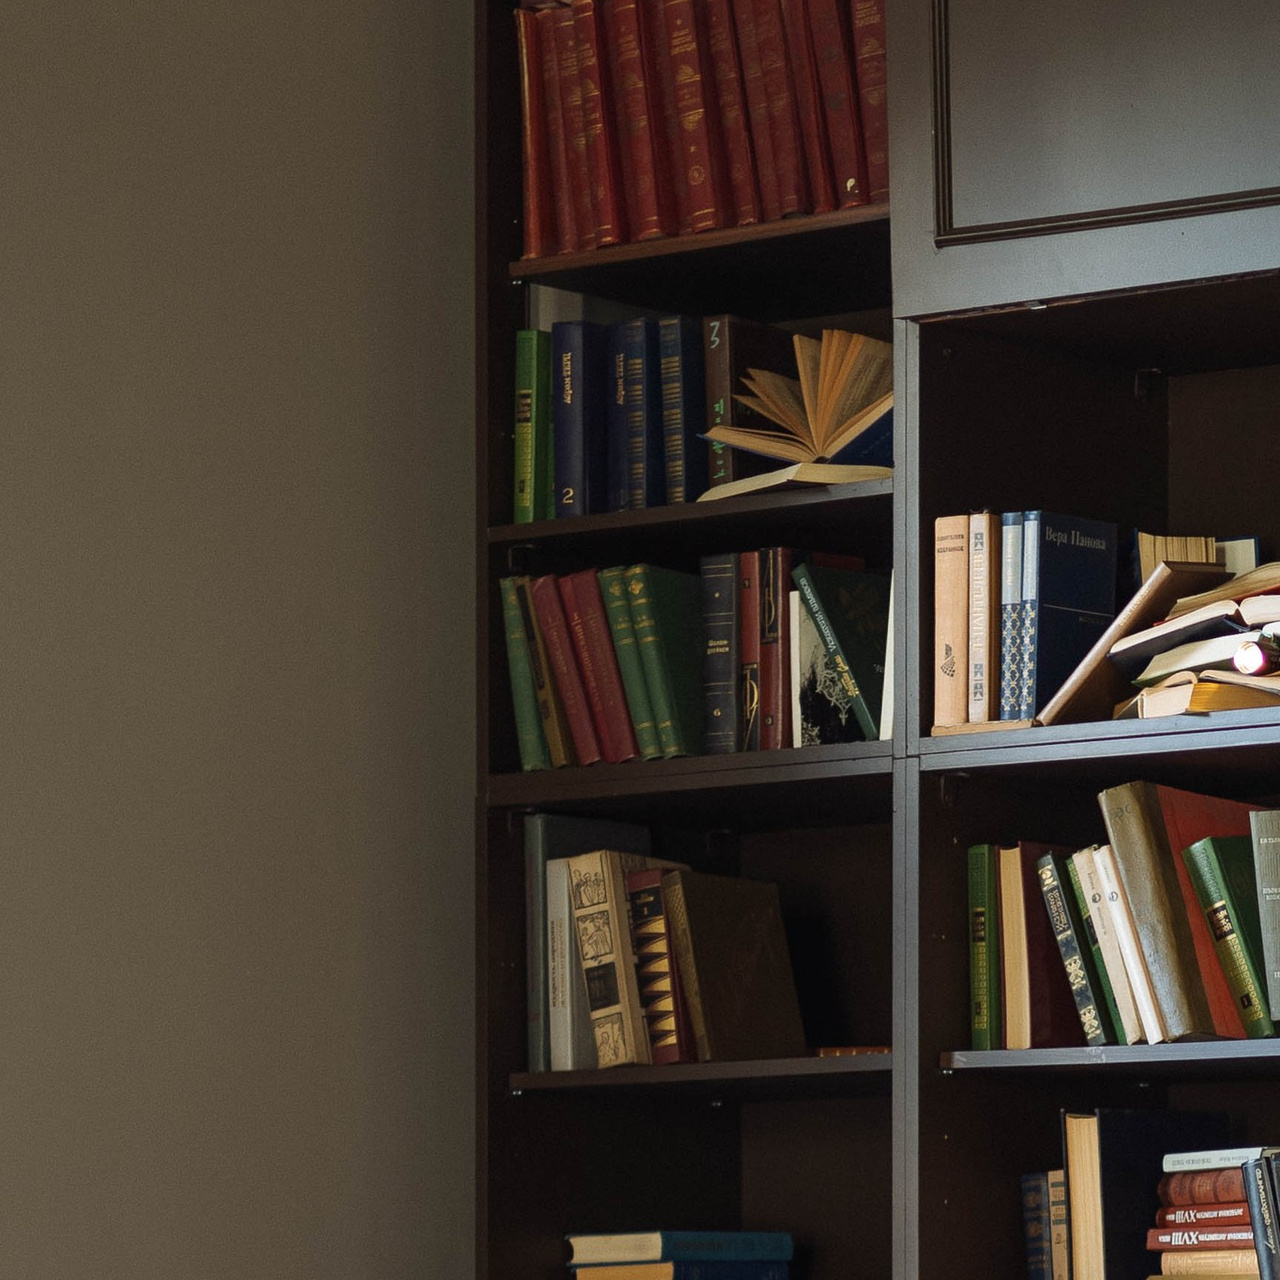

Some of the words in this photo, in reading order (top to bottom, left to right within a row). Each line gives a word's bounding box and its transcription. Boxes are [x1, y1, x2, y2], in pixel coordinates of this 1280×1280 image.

[562, 488, 574, 504] 2
[1045, 525, 1068, 547] Вера
[1071, 530, 1107, 551] Панова
[1175, 1209, 1196, 1223] XVIII
[1170, 1230, 1198, 1245] XVIII
